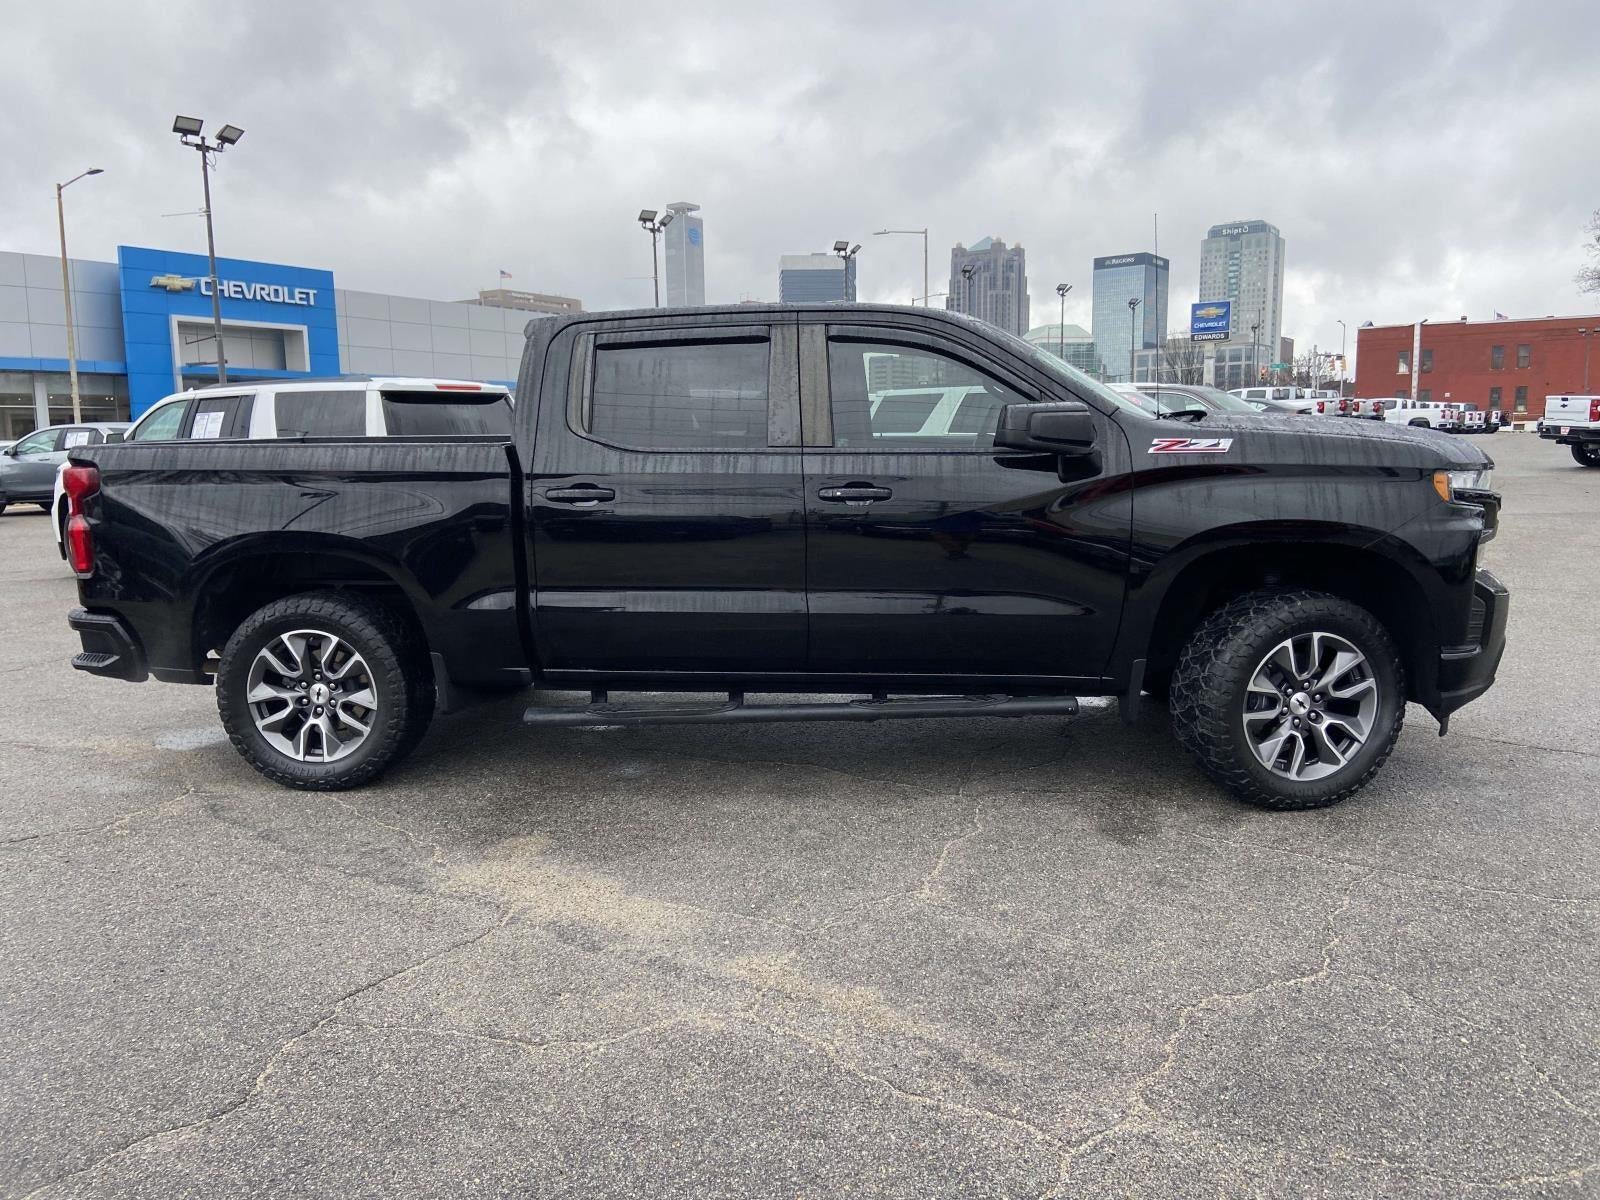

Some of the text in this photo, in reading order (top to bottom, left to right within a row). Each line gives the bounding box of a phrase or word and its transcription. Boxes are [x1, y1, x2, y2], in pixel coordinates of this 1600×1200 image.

[200, 277, 318, 306] CHEVROLET
[1193, 321, 1226, 329] CHEVROLET
[1194, 333, 1225, 341] EDWARDS
